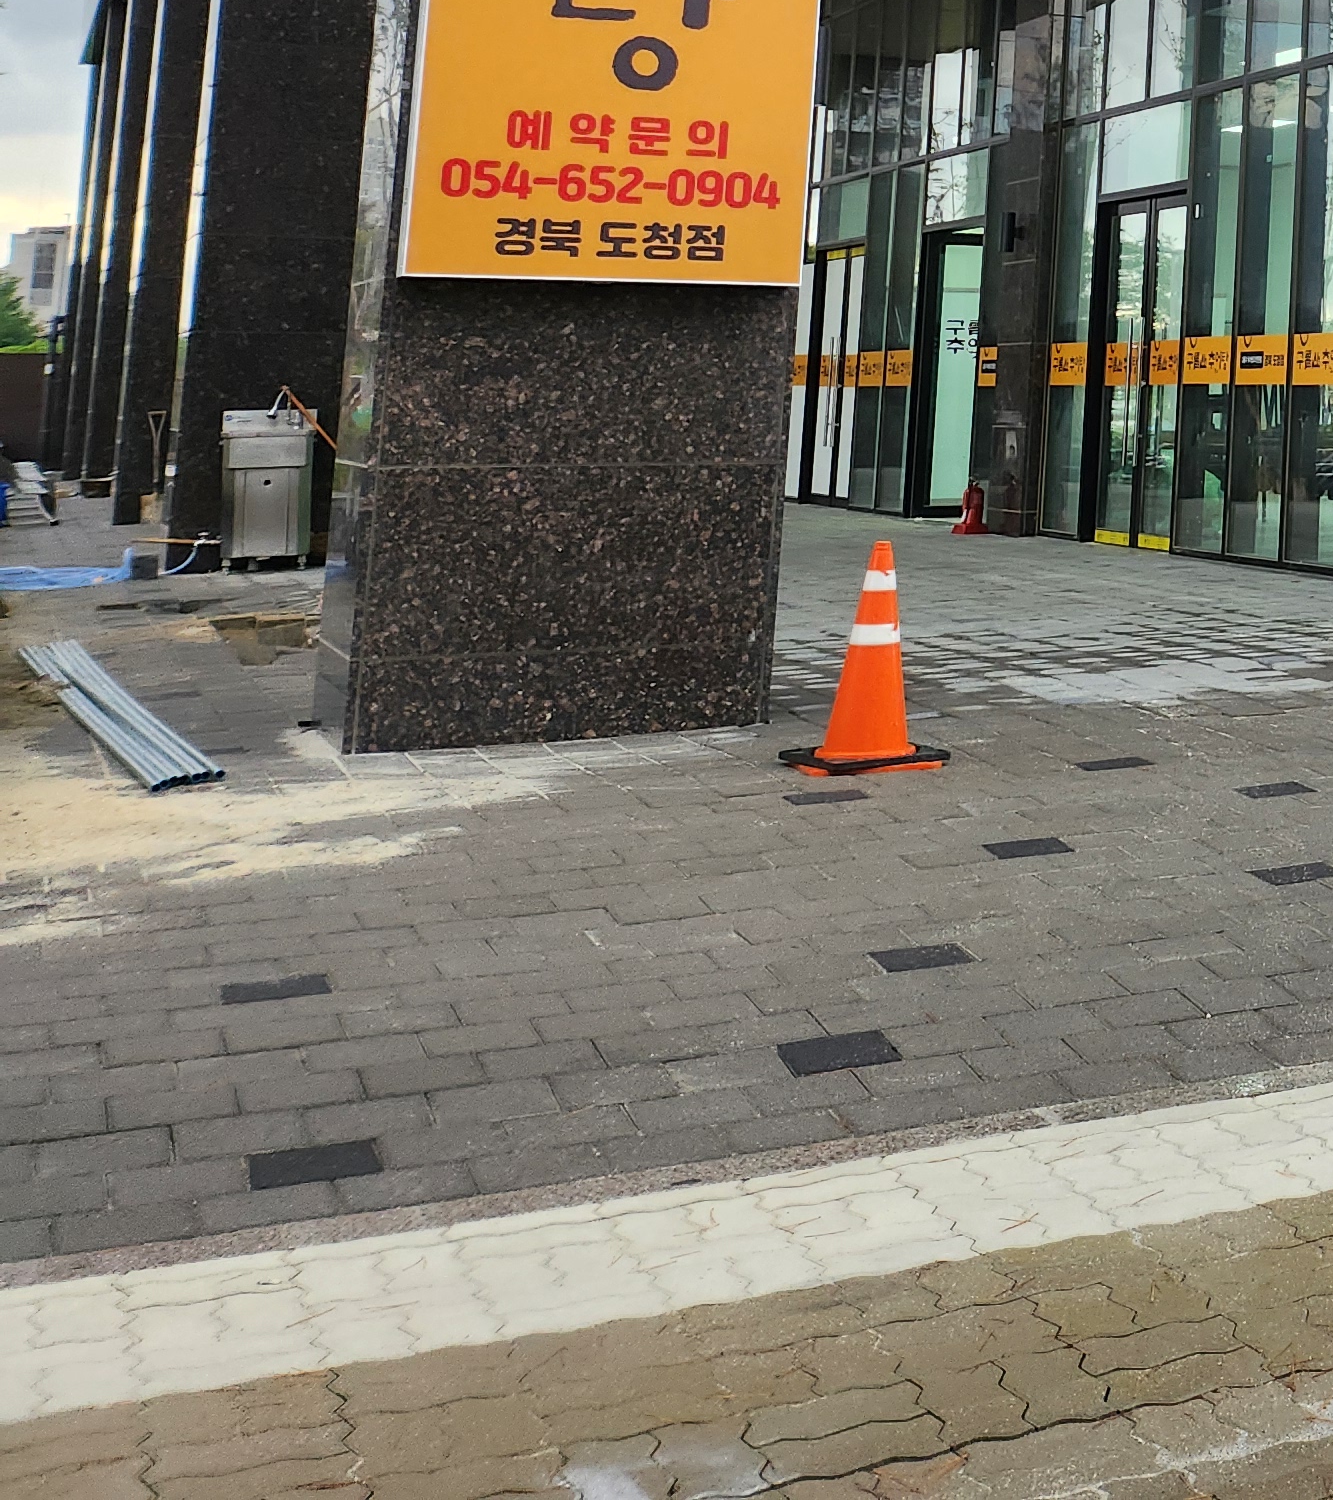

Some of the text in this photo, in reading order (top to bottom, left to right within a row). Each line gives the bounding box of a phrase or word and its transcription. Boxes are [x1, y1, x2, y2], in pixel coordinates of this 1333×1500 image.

[440, 157, 781, 211] 054-652-0904
[494, 217, 727, 262] 경북 도청점
